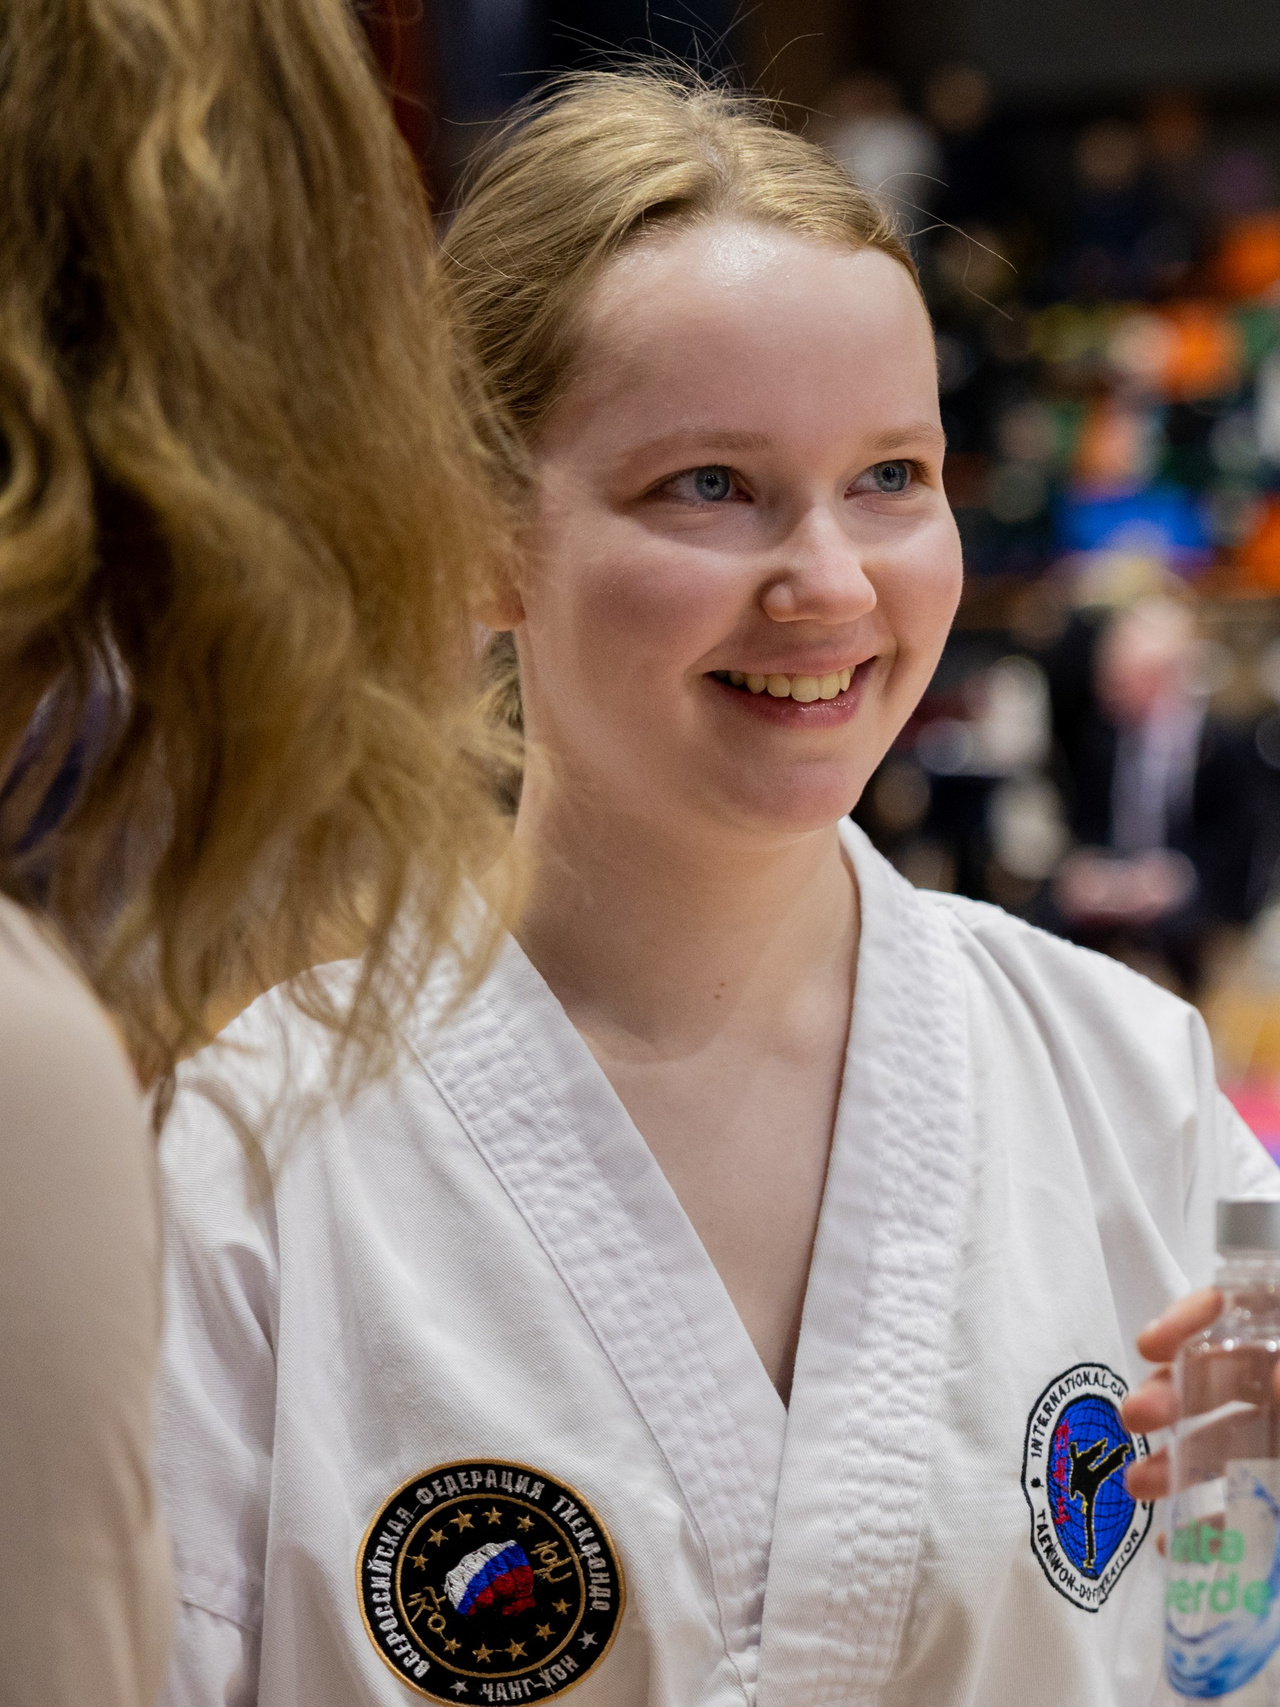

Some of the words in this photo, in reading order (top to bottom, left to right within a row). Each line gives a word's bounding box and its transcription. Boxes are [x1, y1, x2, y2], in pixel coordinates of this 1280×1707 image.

[1030, 1370, 1109, 1458] INTERNATIONAL
[366, 1506, 431, 1679] ВСЕРОССИЙСКАЯ
[415, 1468, 546, 1505] ФЕДЕРАЦИЯ
[481, 1654, 580, 1702] ЧАНГ-ХОН
